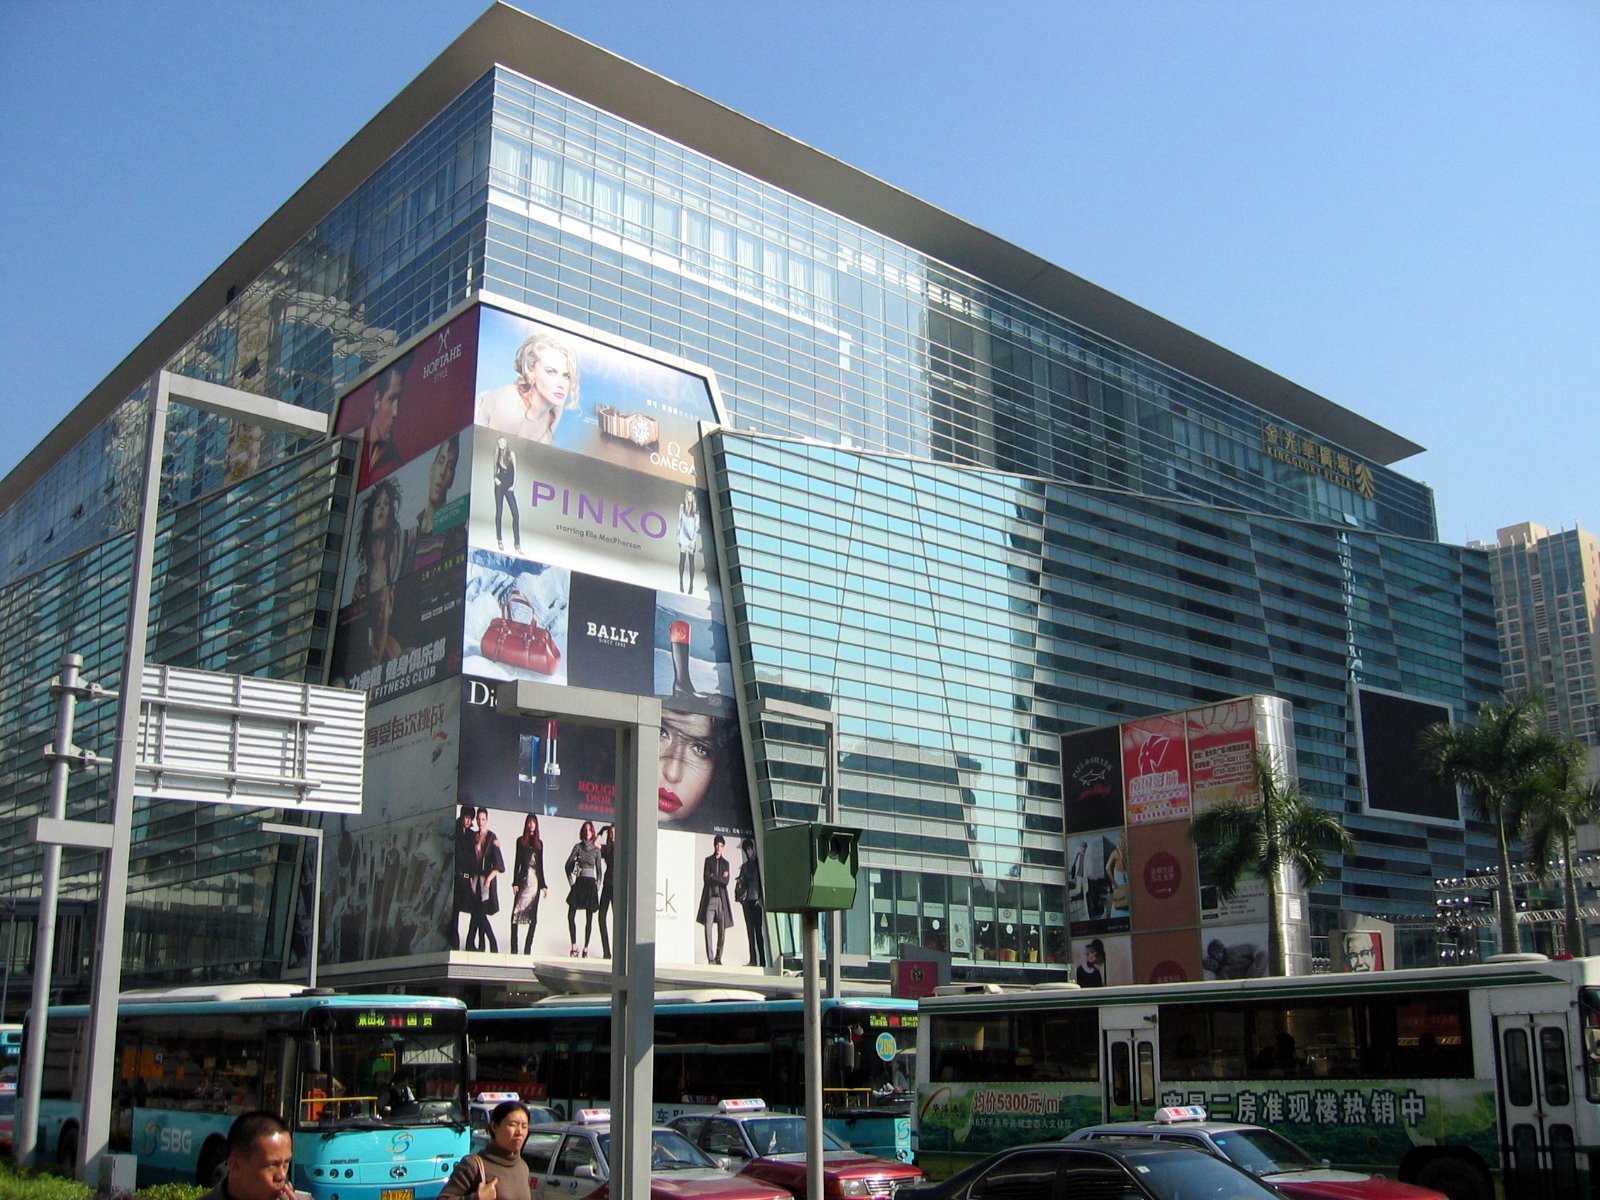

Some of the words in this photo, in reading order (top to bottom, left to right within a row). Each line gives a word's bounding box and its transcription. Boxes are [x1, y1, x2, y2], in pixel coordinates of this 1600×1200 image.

[649, 452, 698, 478] OMEGA
[531, 480, 667, 539] PINKO
[555, 523, 585, 538] starring
[585, 530, 598, 541] Elle
[599, 533, 642, 550] MacPherson
[586, 621, 640, 645] BALLY
[374, 673, 412, 700] FITNESS
[412, 665, 437, 684] CLUB
[466, 680, 498, 708] Di
[586, 792, 611, 805] DIOR
[160, 1127, 192, 1155] SBG
